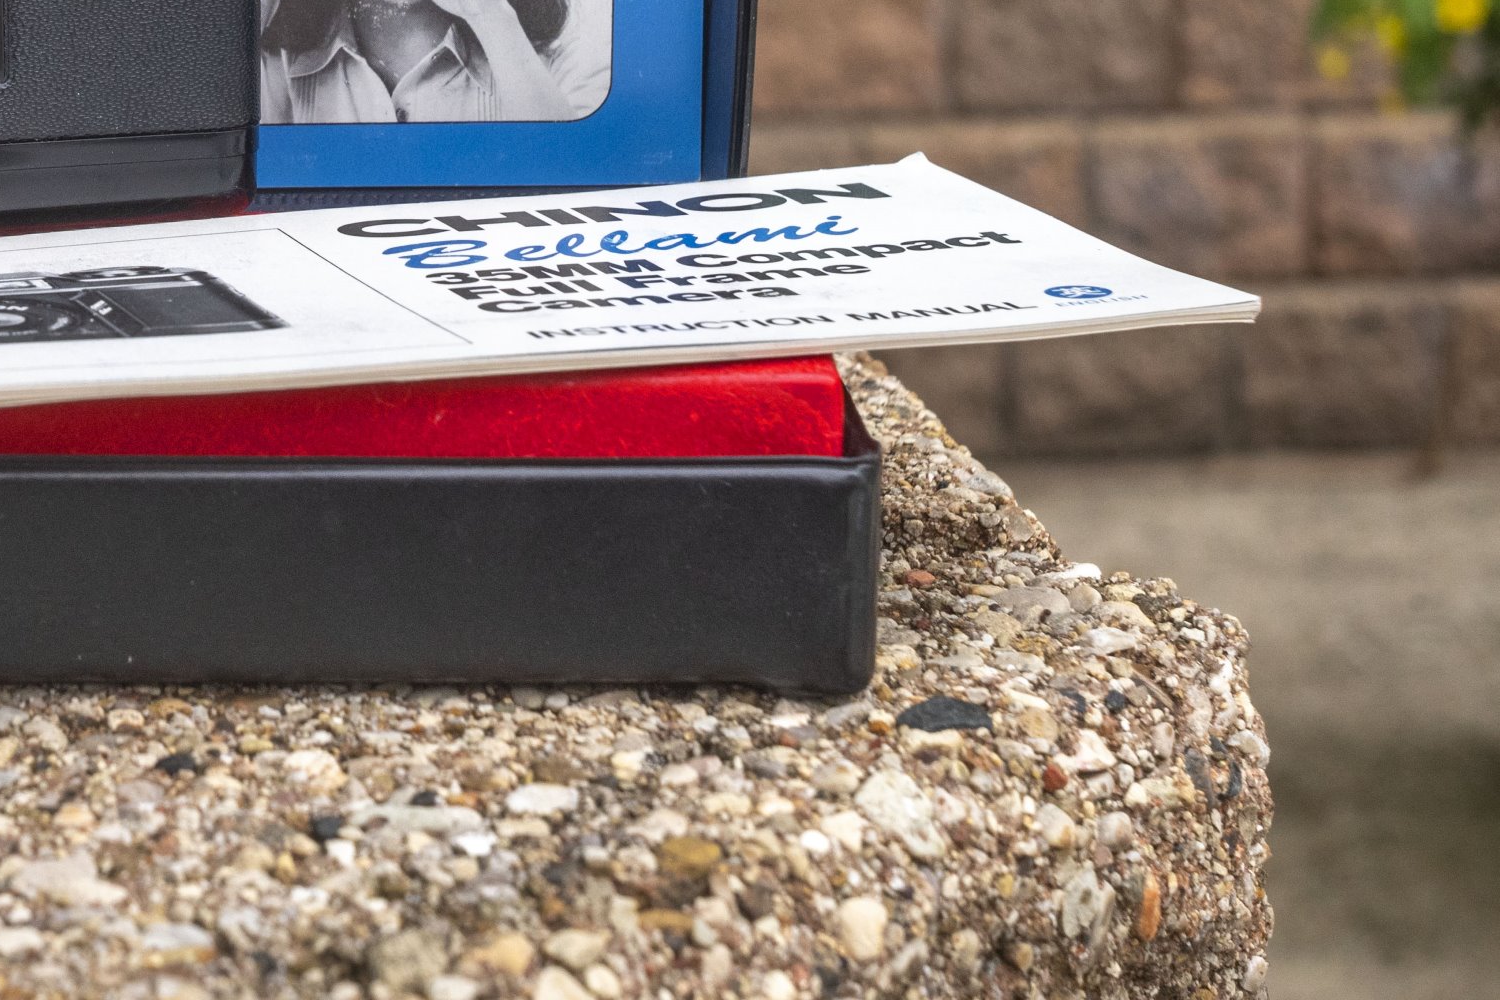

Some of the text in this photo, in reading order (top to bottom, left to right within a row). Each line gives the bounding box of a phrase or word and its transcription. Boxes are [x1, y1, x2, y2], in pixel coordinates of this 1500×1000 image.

[337, 182, 892, 238] CHINON
[382, 215, 859, 269] Bellami
[425, 231, 1022, 285] 35MM Compact
[449, 264, 871, 300] Full Frame
[477, 286, 801, 313] Camera
[1055, 294, 1149, 307] ENGLISH
[526, 300, 1038, 339] INSTRUCTION MANUAL
